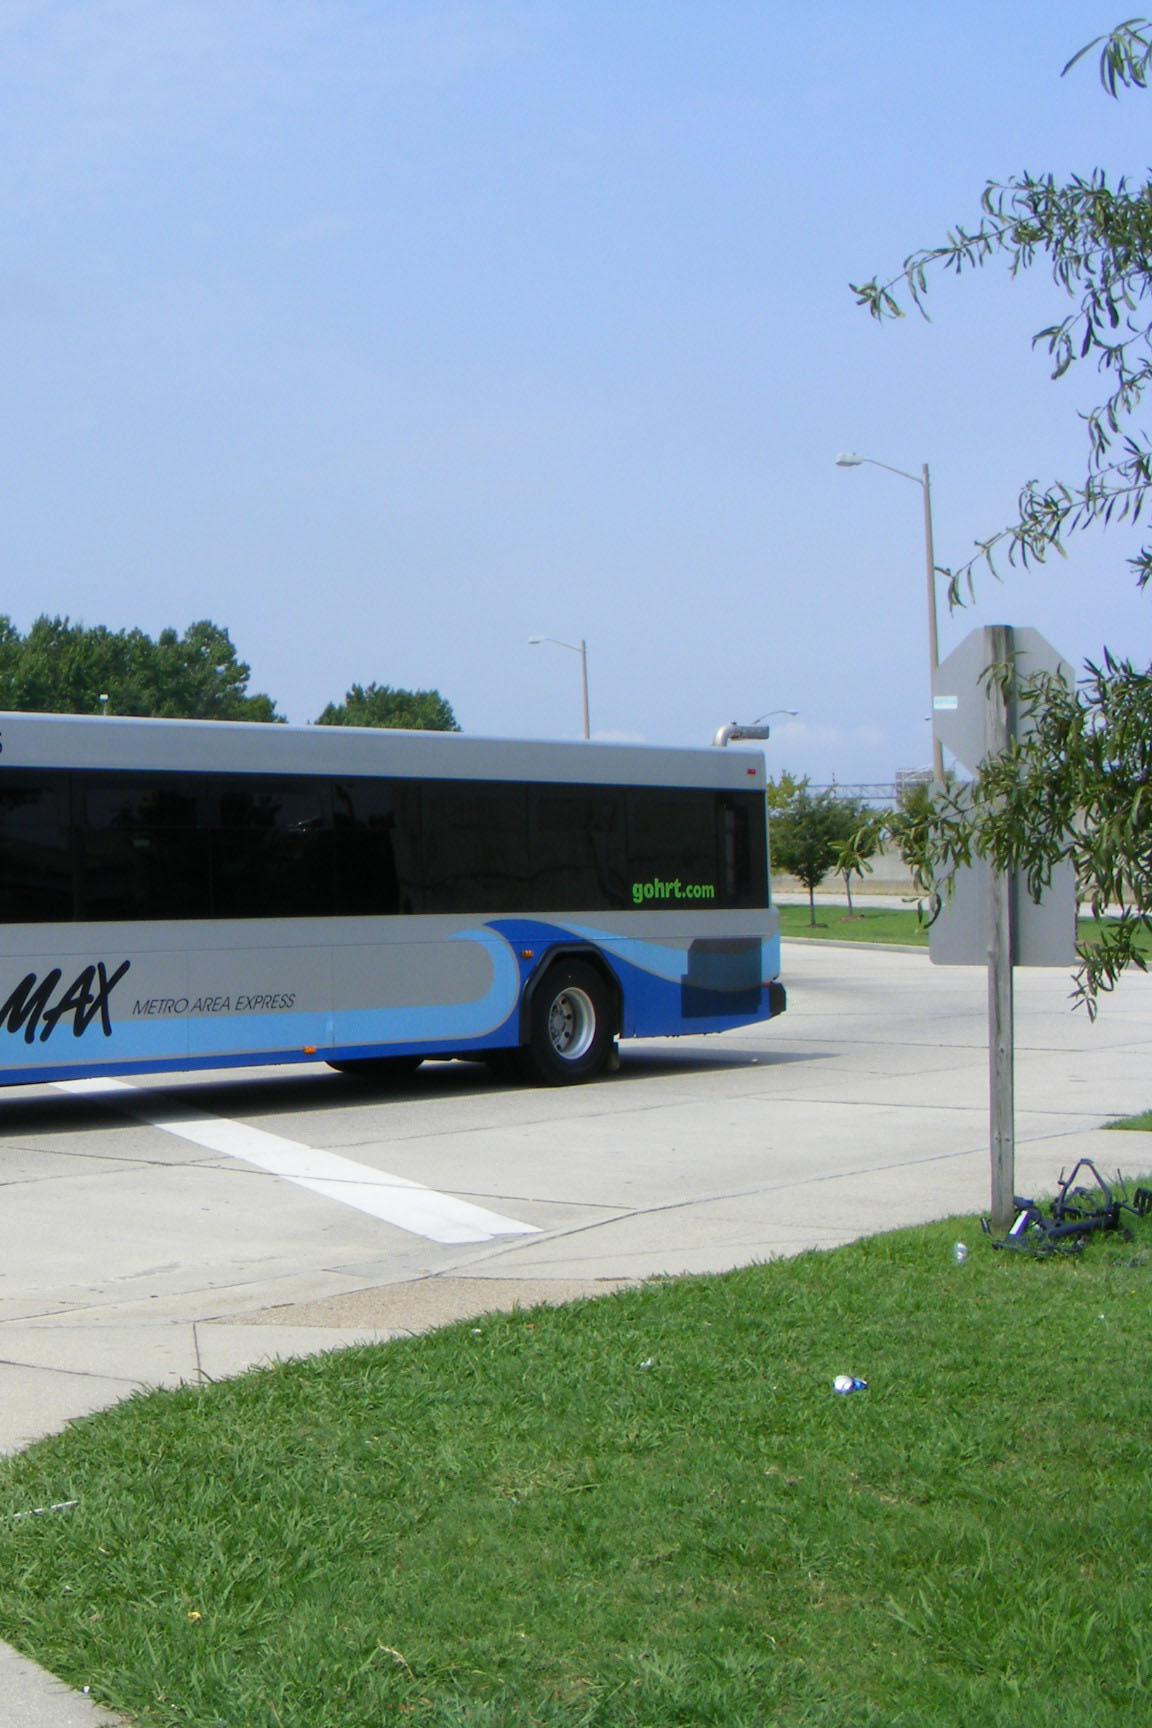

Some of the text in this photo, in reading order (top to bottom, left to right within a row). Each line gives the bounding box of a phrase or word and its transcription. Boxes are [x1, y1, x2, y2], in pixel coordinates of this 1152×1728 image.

[631, 877, 715, 904] gohrt.com
[132, 993, 297, 1015] METRO AREA EXPRESS
